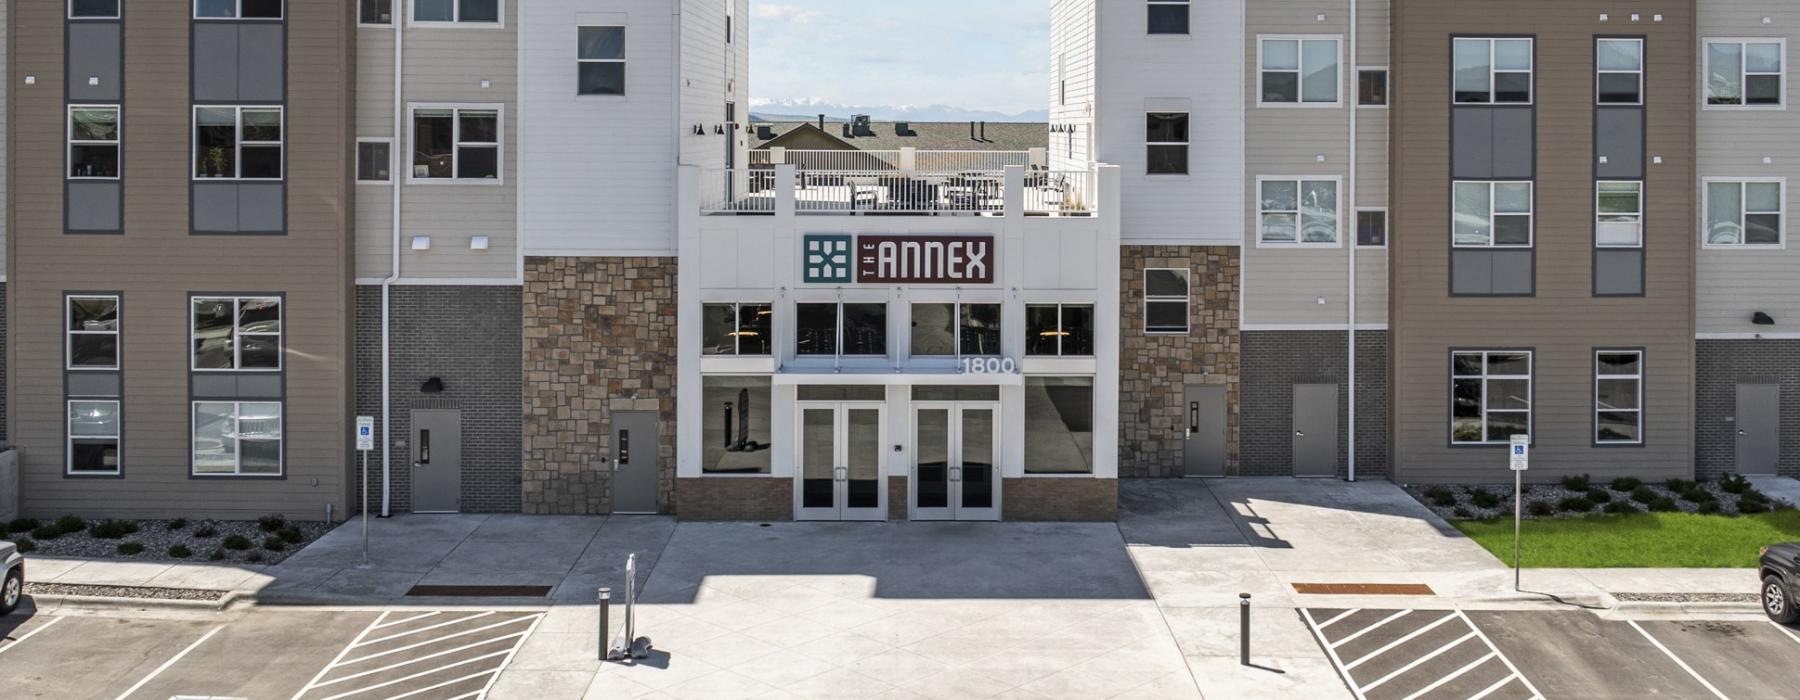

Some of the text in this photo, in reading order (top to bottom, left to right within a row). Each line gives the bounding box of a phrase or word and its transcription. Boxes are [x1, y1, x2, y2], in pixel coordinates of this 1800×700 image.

[863, 241, 986, 278] THE ANNEX
[962, 357, 1015, 374] 1800
